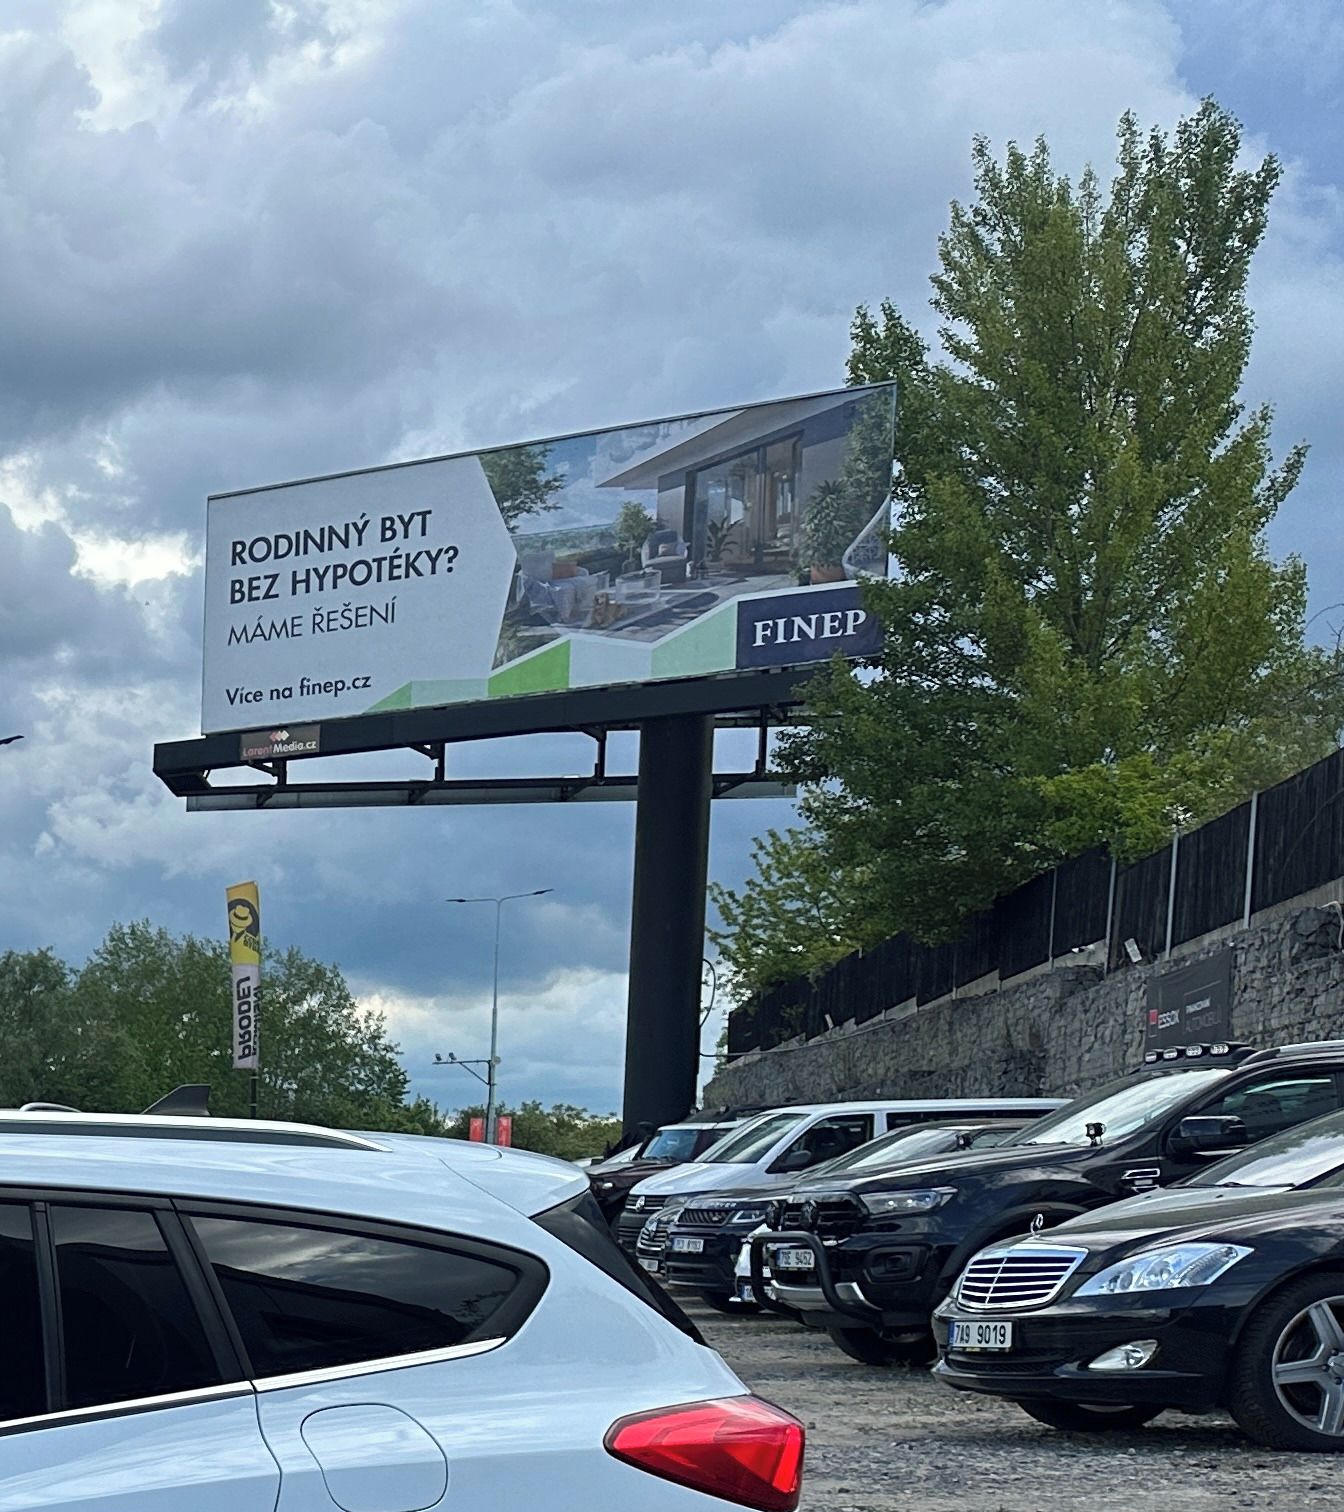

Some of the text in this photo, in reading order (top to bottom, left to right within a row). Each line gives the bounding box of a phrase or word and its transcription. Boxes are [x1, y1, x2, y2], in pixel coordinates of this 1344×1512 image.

[231, 509, 433, 567] RODINNÝ BYT
[230, 545, 459, 605] BEZ HYPOTÉKY?
[227, 595, 398, 646] MÁME ŘEŠENÍ
[752, 609, 867, 647] FINEP
[225, 675, 372, 706] Více na finep.cz
[955, 1324, 1007, 1345] 7A9 9019
